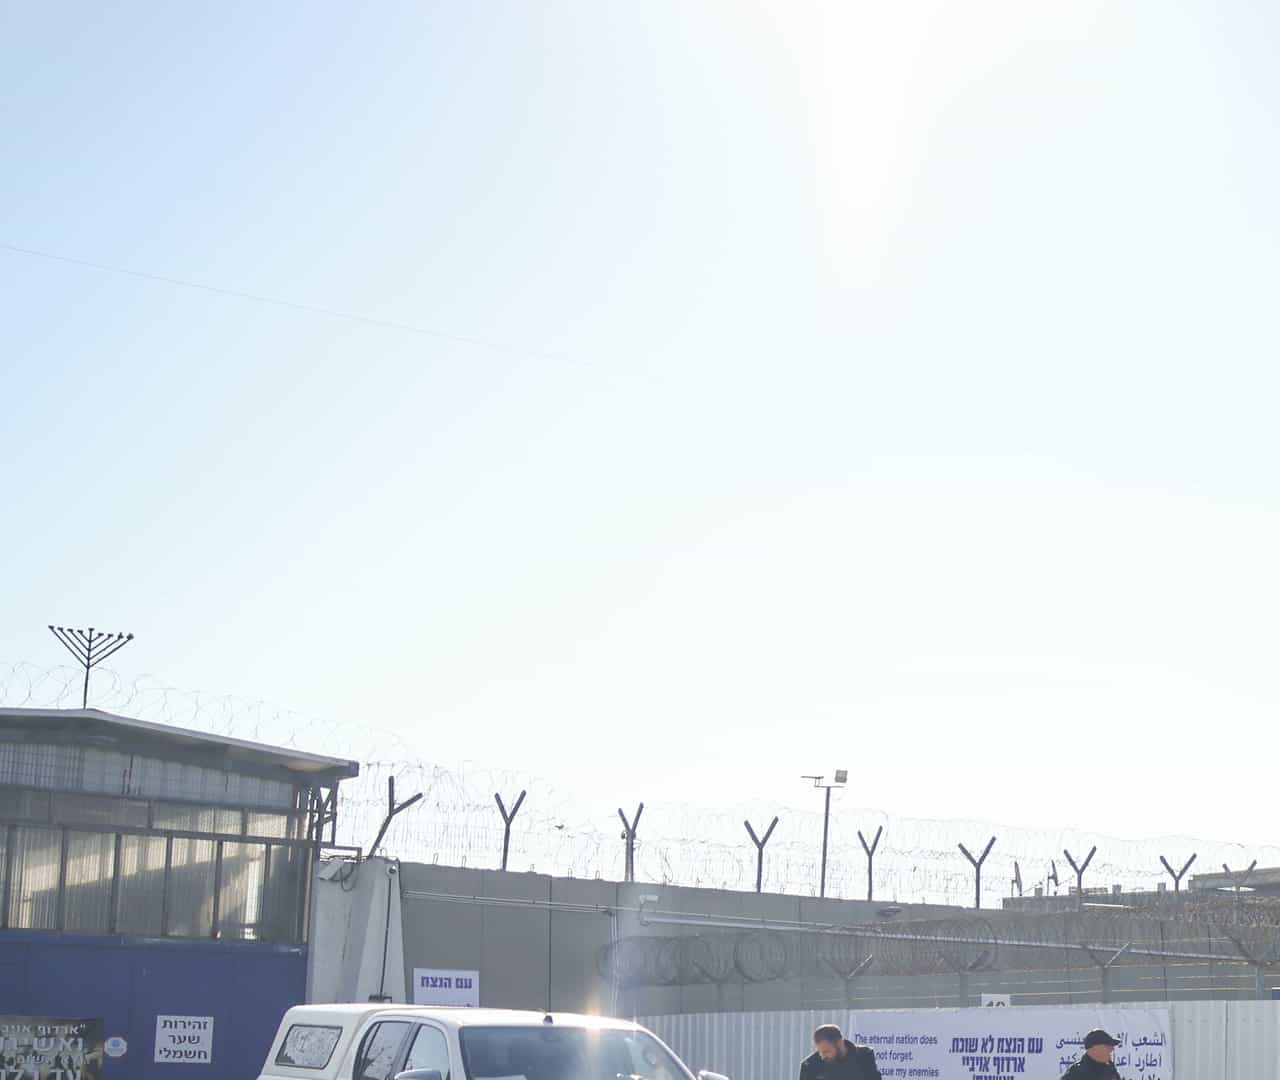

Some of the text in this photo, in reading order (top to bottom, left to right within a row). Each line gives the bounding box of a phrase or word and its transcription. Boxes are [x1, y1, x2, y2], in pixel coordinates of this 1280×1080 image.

[421, 976, 473, 989] עם הנצח
[161, 1020, 208, 1030] זהירות
[168, 1035, 200, 1045] שער
[855, 1033, 938, 1045] The eternal nation does
[980, 1034, 995, 1054] לא
[996, 1037, 1025, 1054] הנצח
[1027, 1037, 1044, 1054] עם
[159, 1048, 208, 1059] חשמלי
[992, 1056, 1026, 1075] ארדוף
[908, 1066, 940, 1078] enemies
